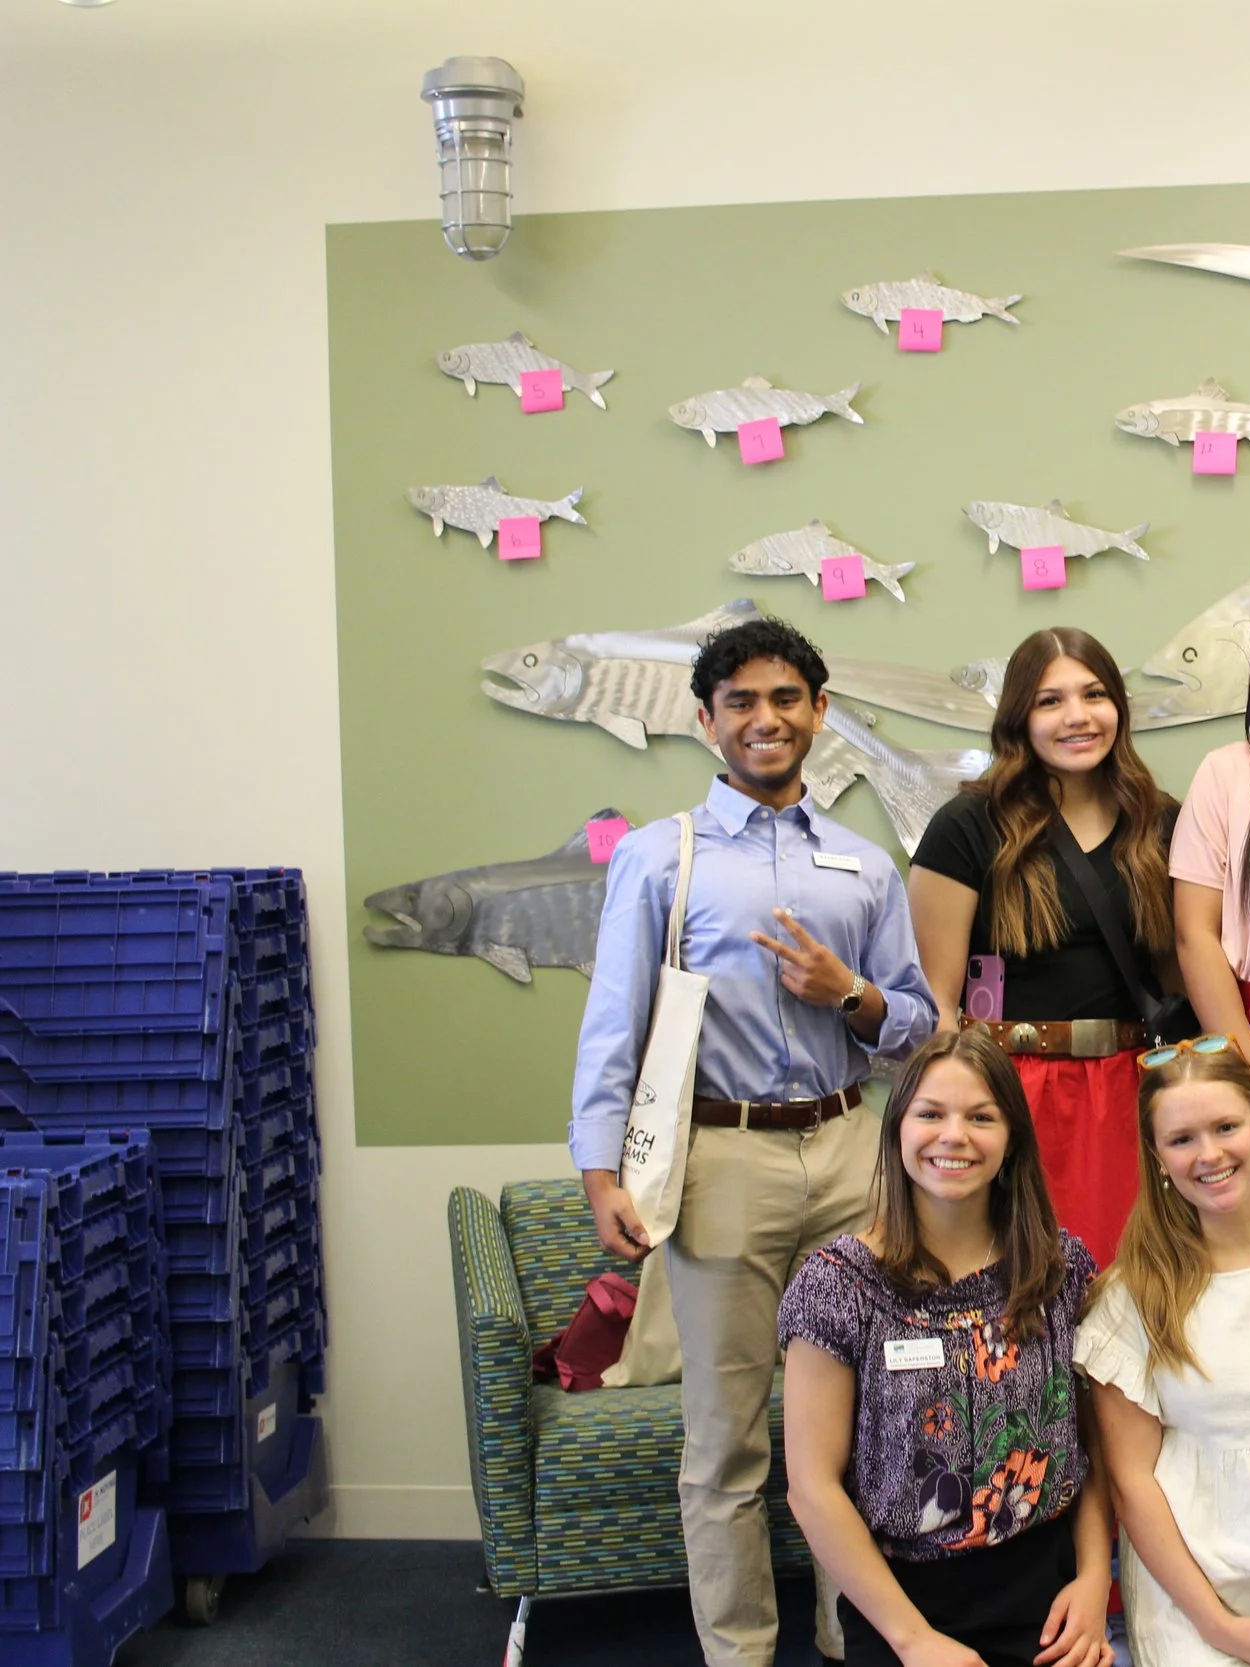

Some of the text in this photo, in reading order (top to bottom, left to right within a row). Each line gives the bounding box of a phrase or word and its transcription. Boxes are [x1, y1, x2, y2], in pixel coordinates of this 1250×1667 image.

[913, 322, 924, 339] 4
[532, 383, 545, 399] 5
[510, 534, 521, 546] 6
[832, 567, 845, 585] 9
[1033, 559, 1049, 577] 8
[598, 834, 614, 847] 10
